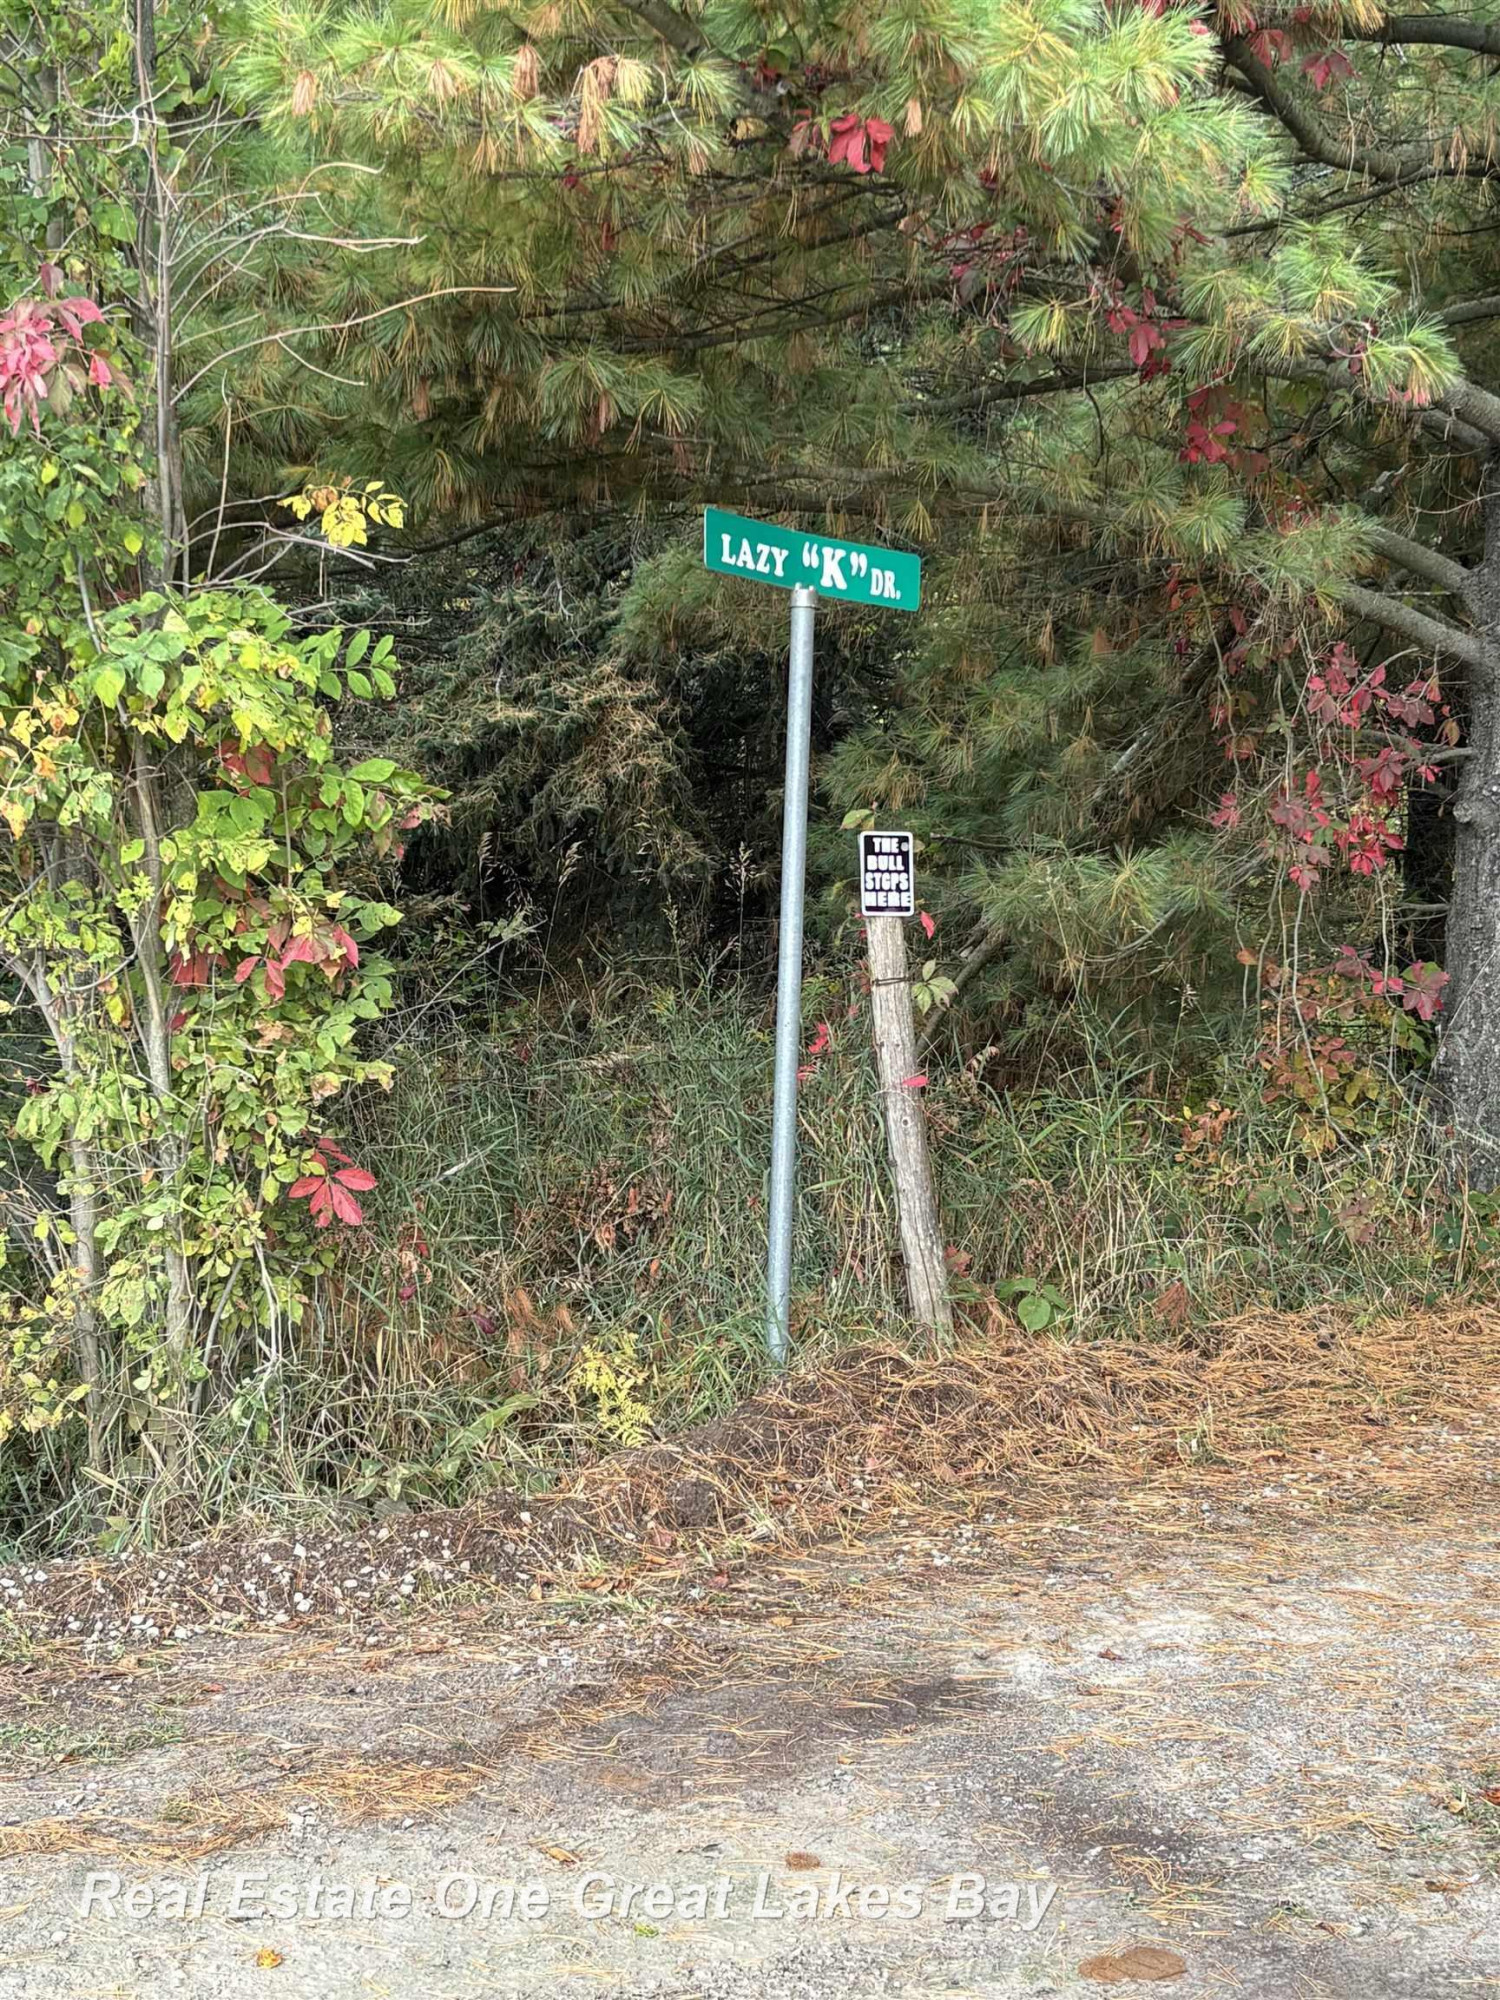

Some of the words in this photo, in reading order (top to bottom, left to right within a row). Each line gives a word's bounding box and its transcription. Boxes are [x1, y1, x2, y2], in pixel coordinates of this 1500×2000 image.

[721, 533, 789, 577] LAZY
[869, 568, 901, 600] DR.
[872, 837, 899, 853] THE
[866, 854, 905, 871] BULL
[865, 871, 909, 890] STOPS
[864, 891, 912, 907] HERE
